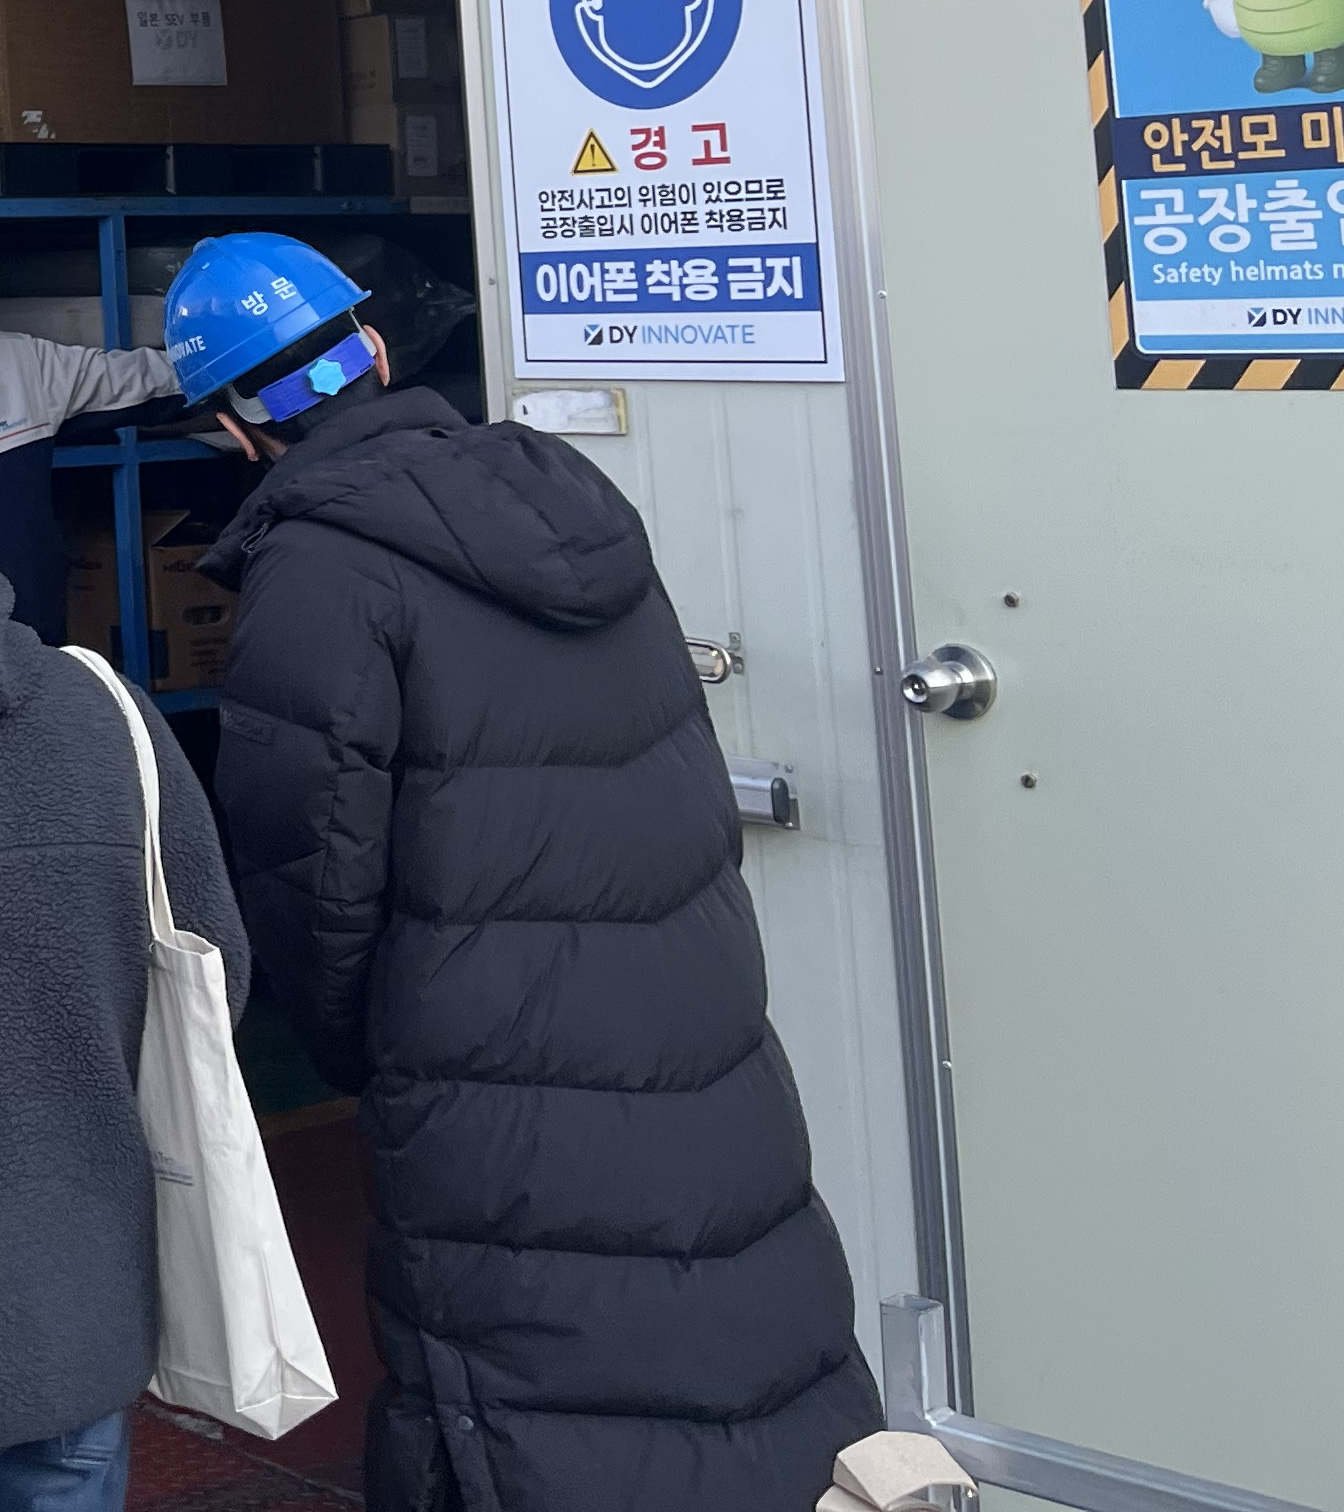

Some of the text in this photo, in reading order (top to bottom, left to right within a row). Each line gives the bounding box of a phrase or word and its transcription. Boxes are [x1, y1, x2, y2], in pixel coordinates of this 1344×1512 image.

[137, 11, 160, 28] 일본
[1143, 114, 1286, 172] 안전모
[538, 178, 786, 213] 안전사고의 위험이 있으므로
[541, 207, 788, 240] 공장출입시 이어폰 착용금지
[536, 256, 803, 303] 이어폰 착용 금지
[1153, 262, 1223, 286] Safety
[1230, 259, 1325, 282] helmats
[1272, 308, 1302, 326] DY
[608, 324, 756, 345] DY INNOVATE
